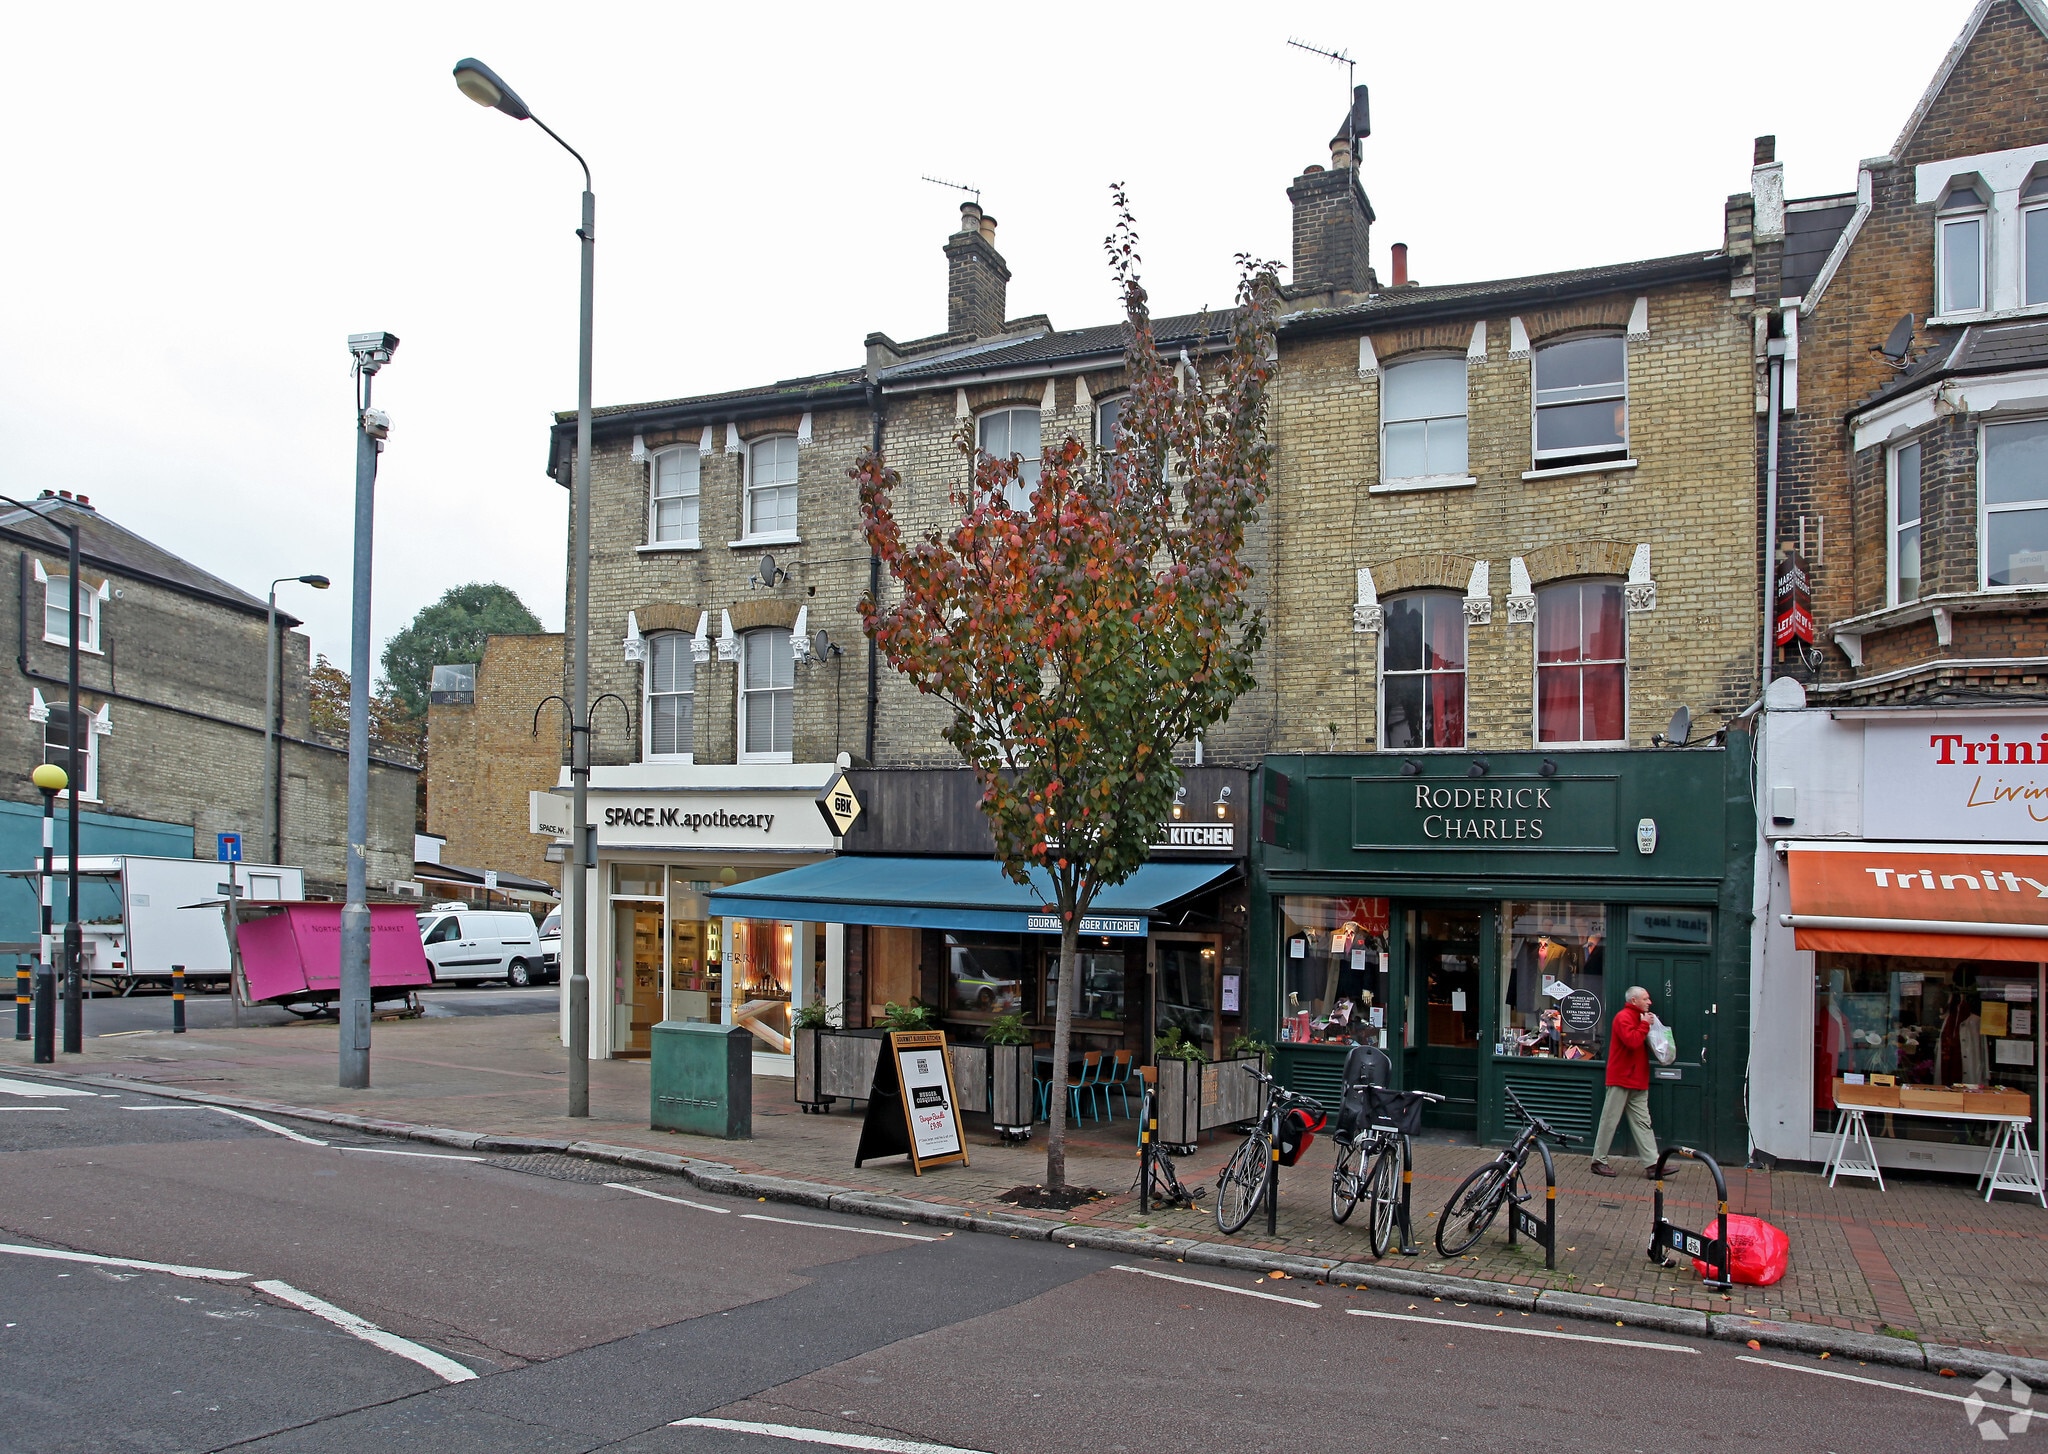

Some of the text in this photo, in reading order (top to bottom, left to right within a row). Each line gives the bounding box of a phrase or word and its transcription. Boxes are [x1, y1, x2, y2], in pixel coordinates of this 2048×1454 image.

[1778, 569, 1794, 588] MARS
[835, 797, 852, 814] GBK
[1414, 784, 1552, 809] RODERICK
[1967, 775, 2048, 822] Livin
[1170, 827, 1234, 845] KITCHEN
[1423, 814, 1544, 840] CHARLES
[1338, 897, 1386, 918] SAL
[312, 925, 341, 933] NORTHC
[1028, 917, 1140, 931] GOURME RGER KITCHEN
